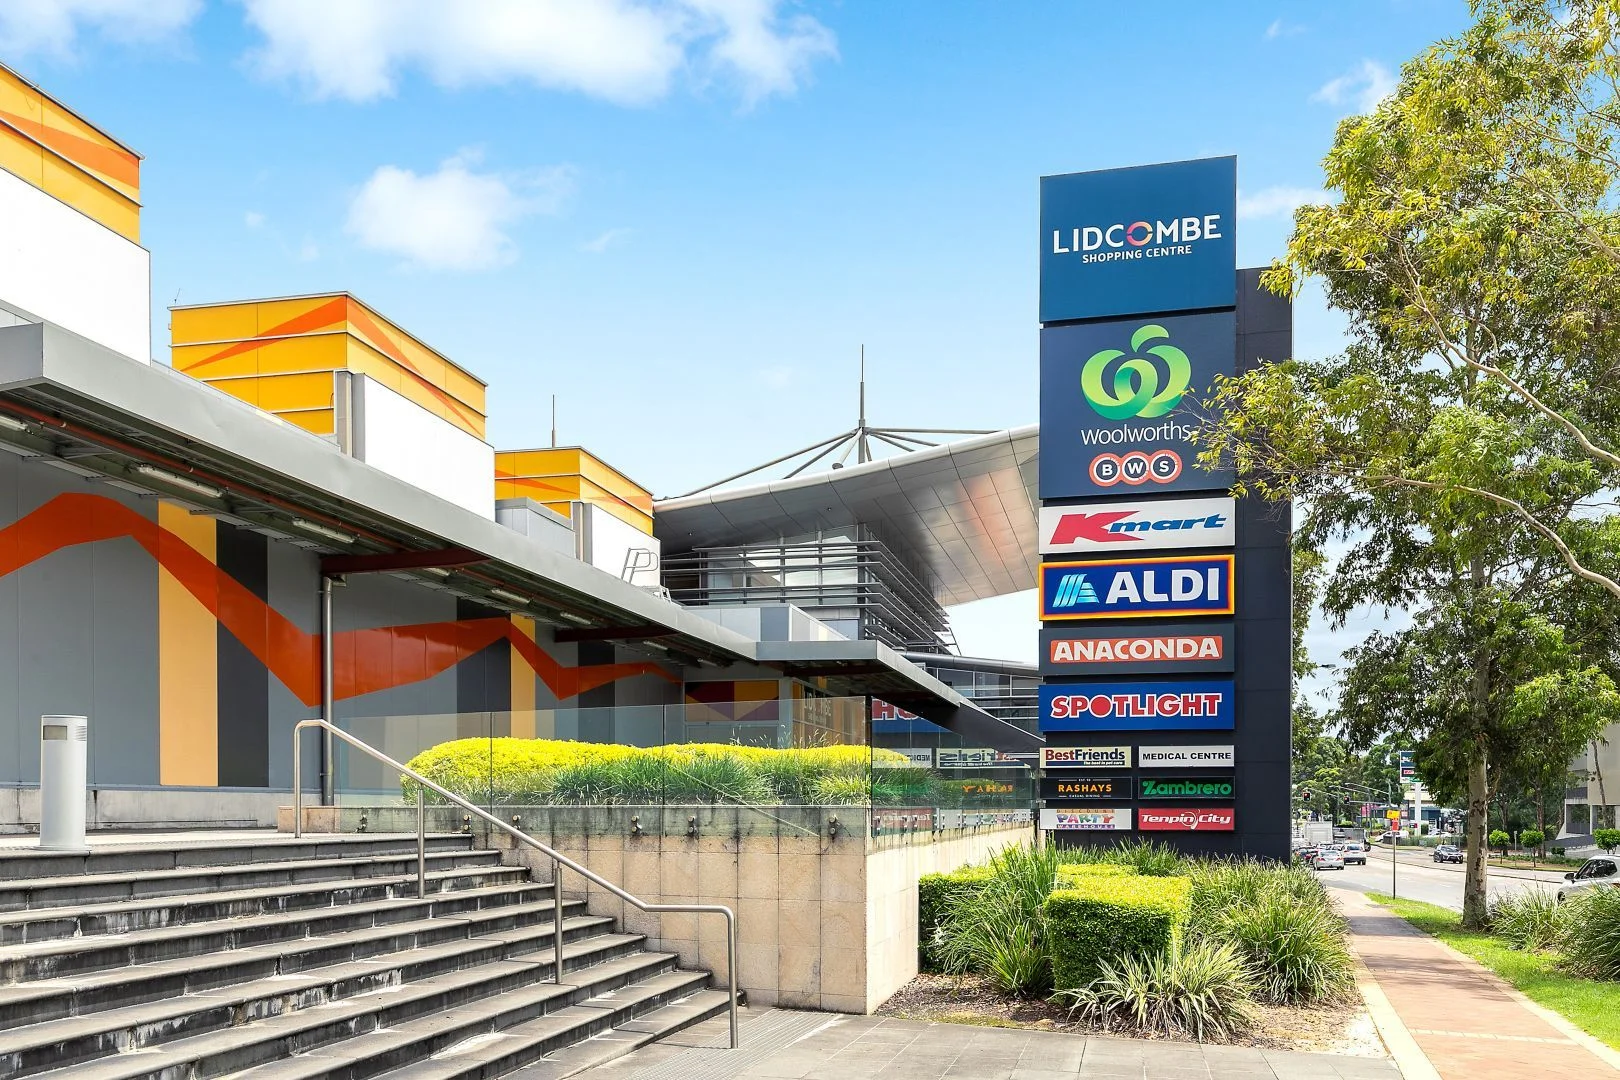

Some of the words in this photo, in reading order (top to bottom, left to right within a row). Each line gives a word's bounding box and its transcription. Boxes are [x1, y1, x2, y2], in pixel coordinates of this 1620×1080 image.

[1053, 214, 1222, 254] LIDCOMBE
[1082, 248, 1142, 264] SHOPPING
[1146, 245, 1192, 259] CENTRE
[1081, 420, 1192, 446] Woolworths
[1101, 460, 1170, 476] BWS
[1050, 510, 1227, 545] Kmart
[1105, 567, 1220, 604] ALDI
[1053, 637, 1220, 661] ANACONDA
[1050, 692, 1222, 718] SPOTLIGHT
[1142, 752, 1188, 760] MEDICAL
[1190, 752, 1232, 760] CENTRE
[1058, 784, 1112, 792] RASHAYS
[1142, 781, 1232, 795] Zambrero
[1056, 814, 1115, 823] PARTY
